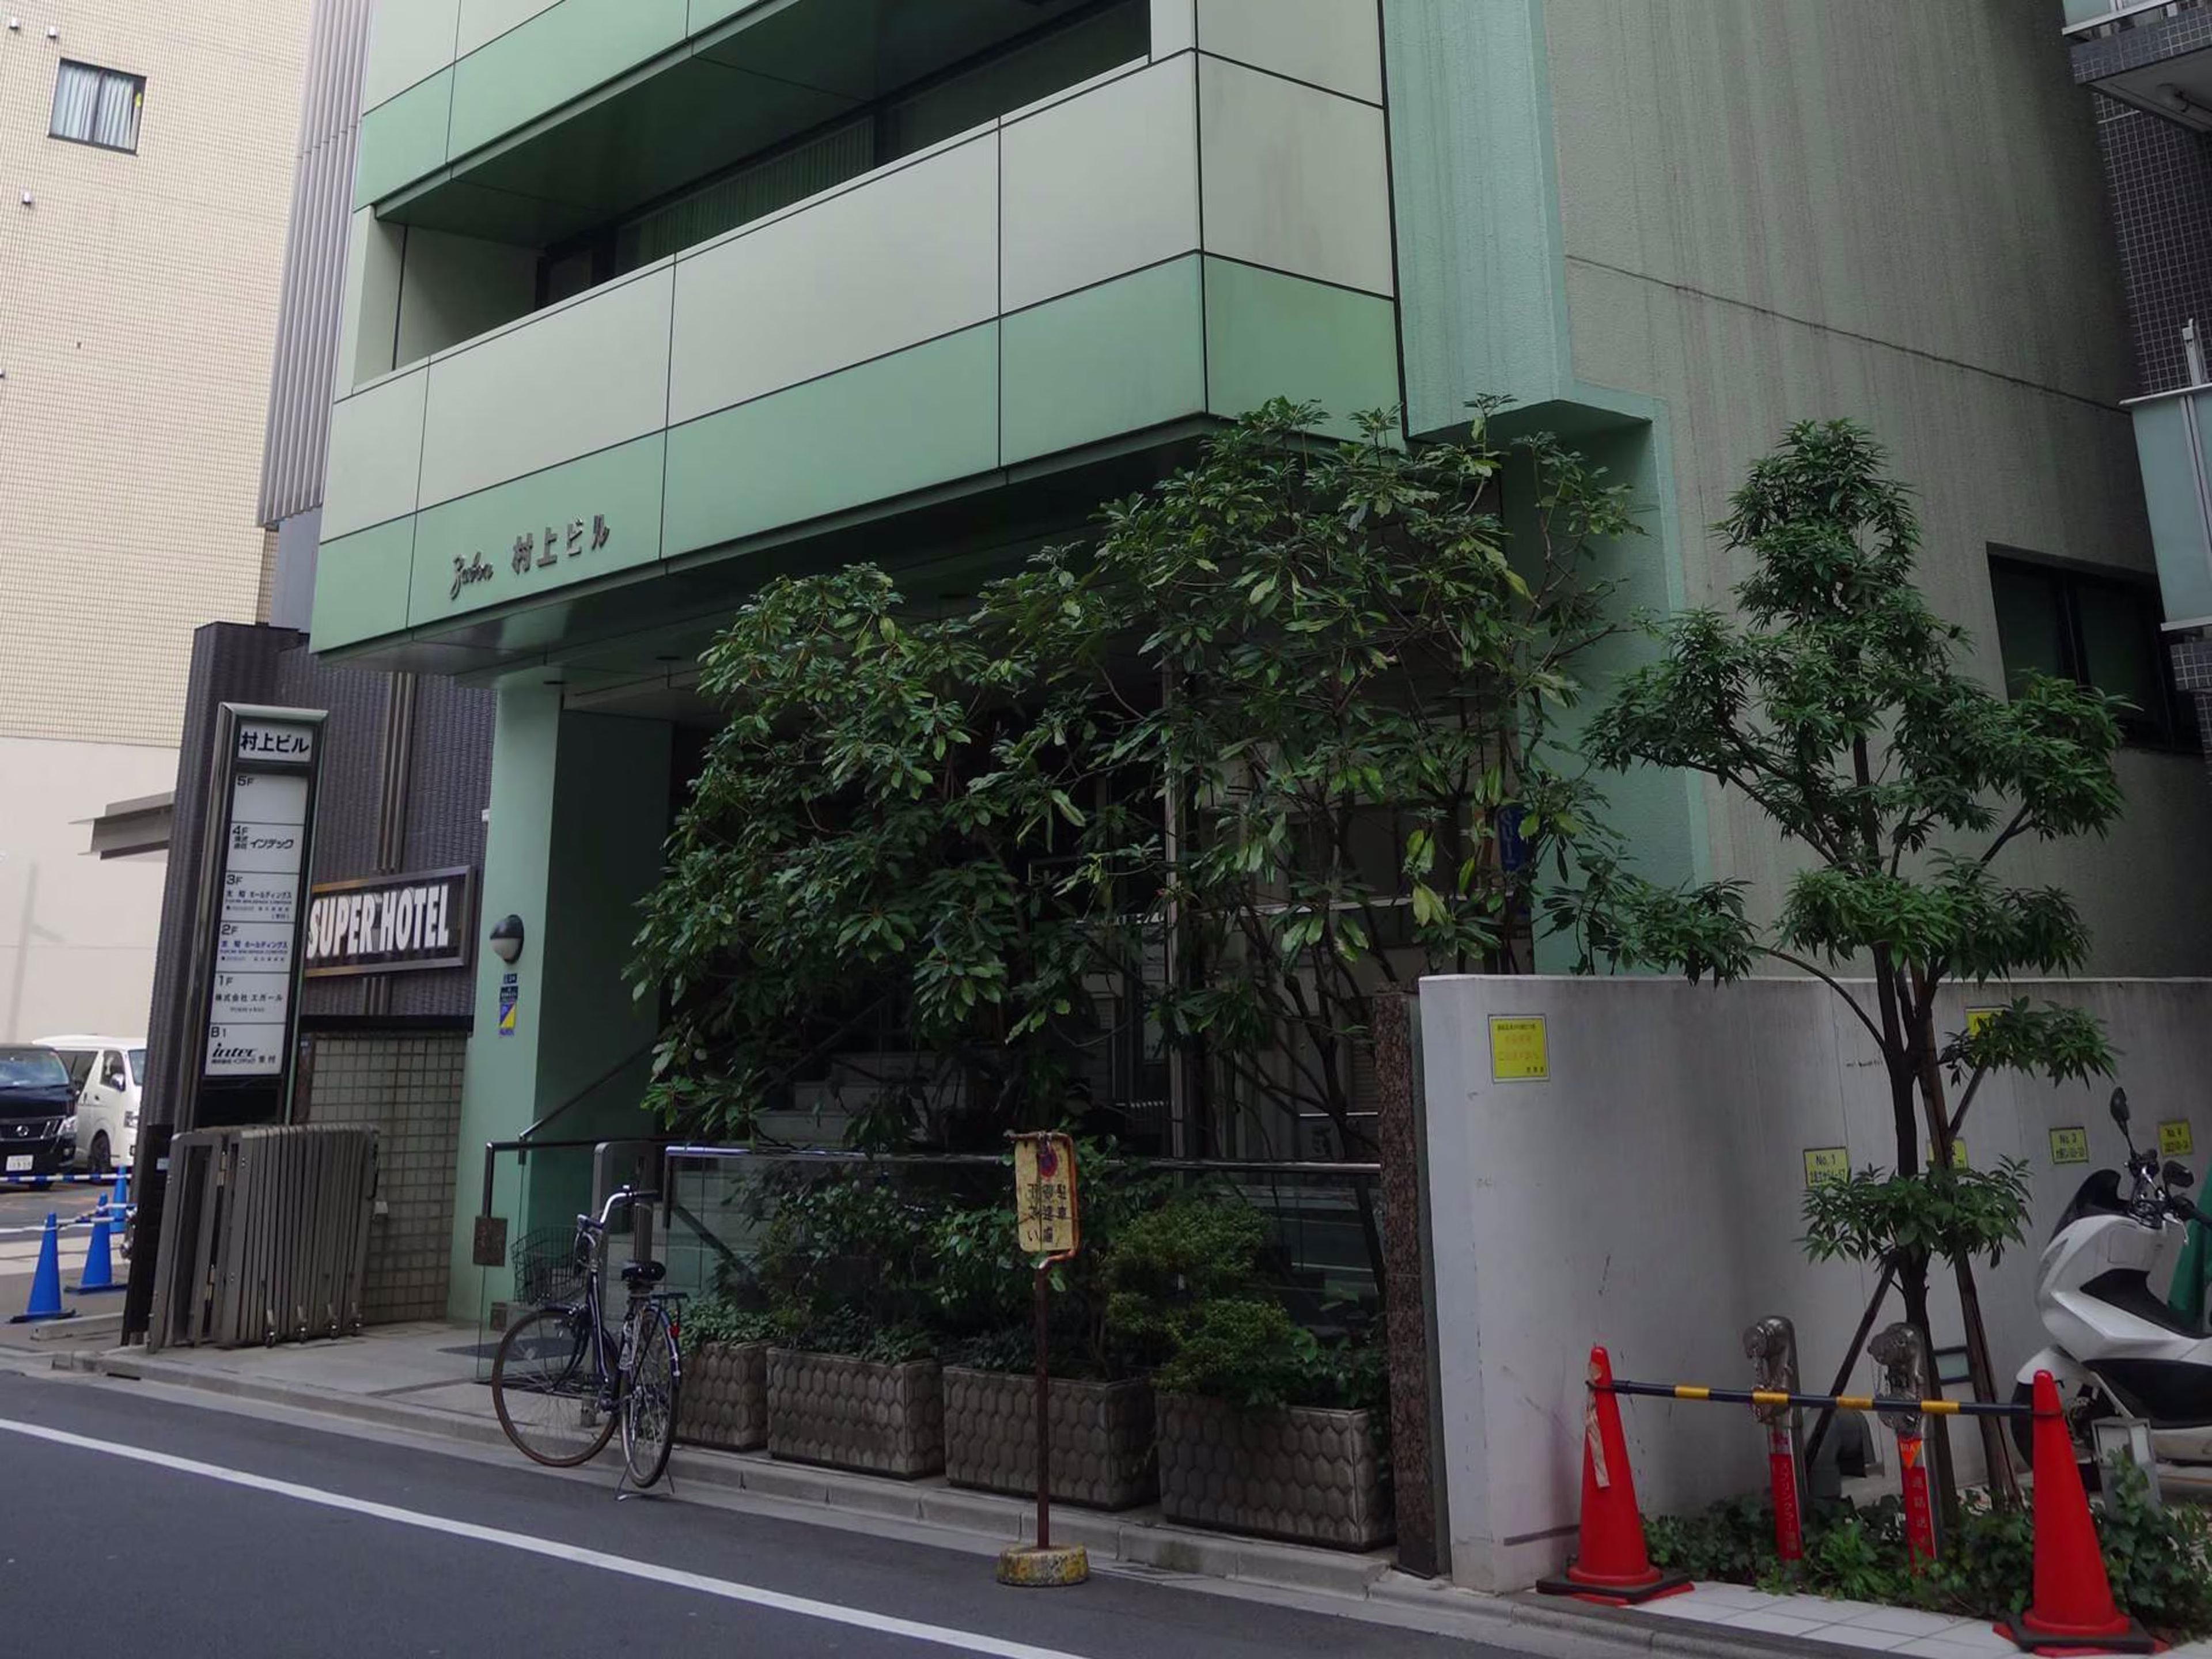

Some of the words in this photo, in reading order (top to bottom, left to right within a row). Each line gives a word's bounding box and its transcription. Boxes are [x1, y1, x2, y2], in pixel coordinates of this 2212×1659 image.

[512, 514, 611, 575] 村上ビル
[240, 731, 310, 753] 村上ビル
[237, 775, 254, 786] 5F
[232, 825, 249, 836] 4F
[226, 874, 243, 885] 3F
[306, 893, 376, 959] SUPER
[379, 885, 449, 952] HOTEL
[221, 924, 238, 935] 2F
[218, 975, 233, 986] 1F
[211, 1026, 226, 1038] B1
